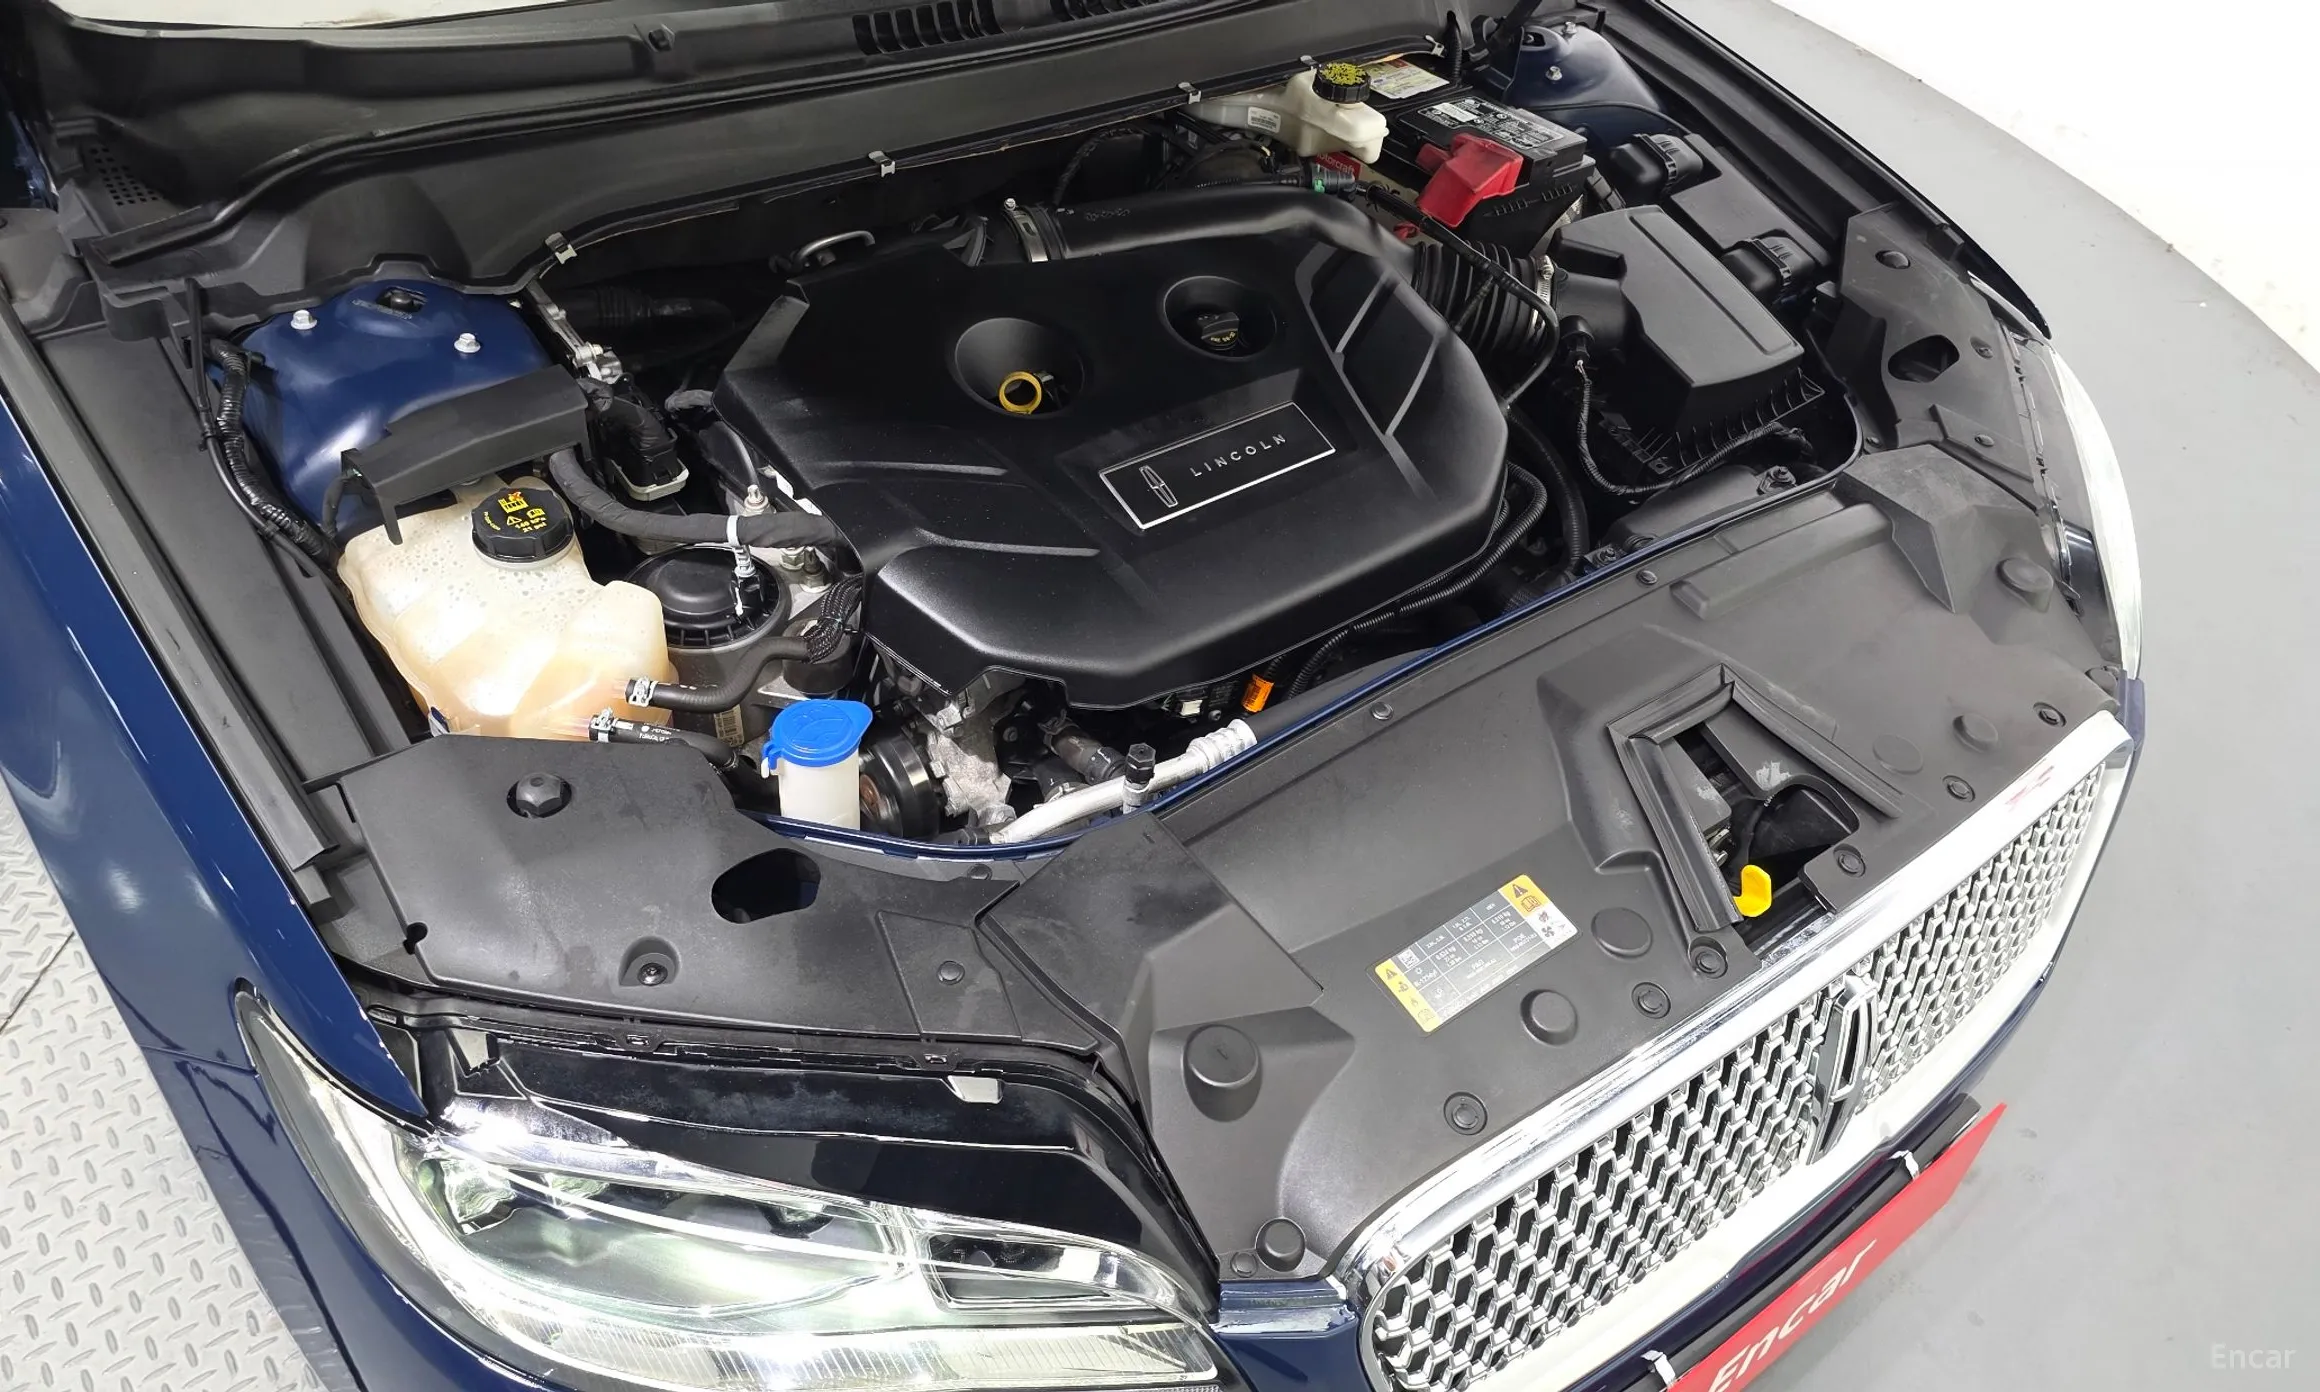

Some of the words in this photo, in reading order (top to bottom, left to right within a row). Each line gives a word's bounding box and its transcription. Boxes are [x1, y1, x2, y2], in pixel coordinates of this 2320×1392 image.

[1317, 153, 1354, 175] otorcraft
[1189, 432, 1287, 477] LINCOLN
[1708, 1238, 1877, 1392] Encar
